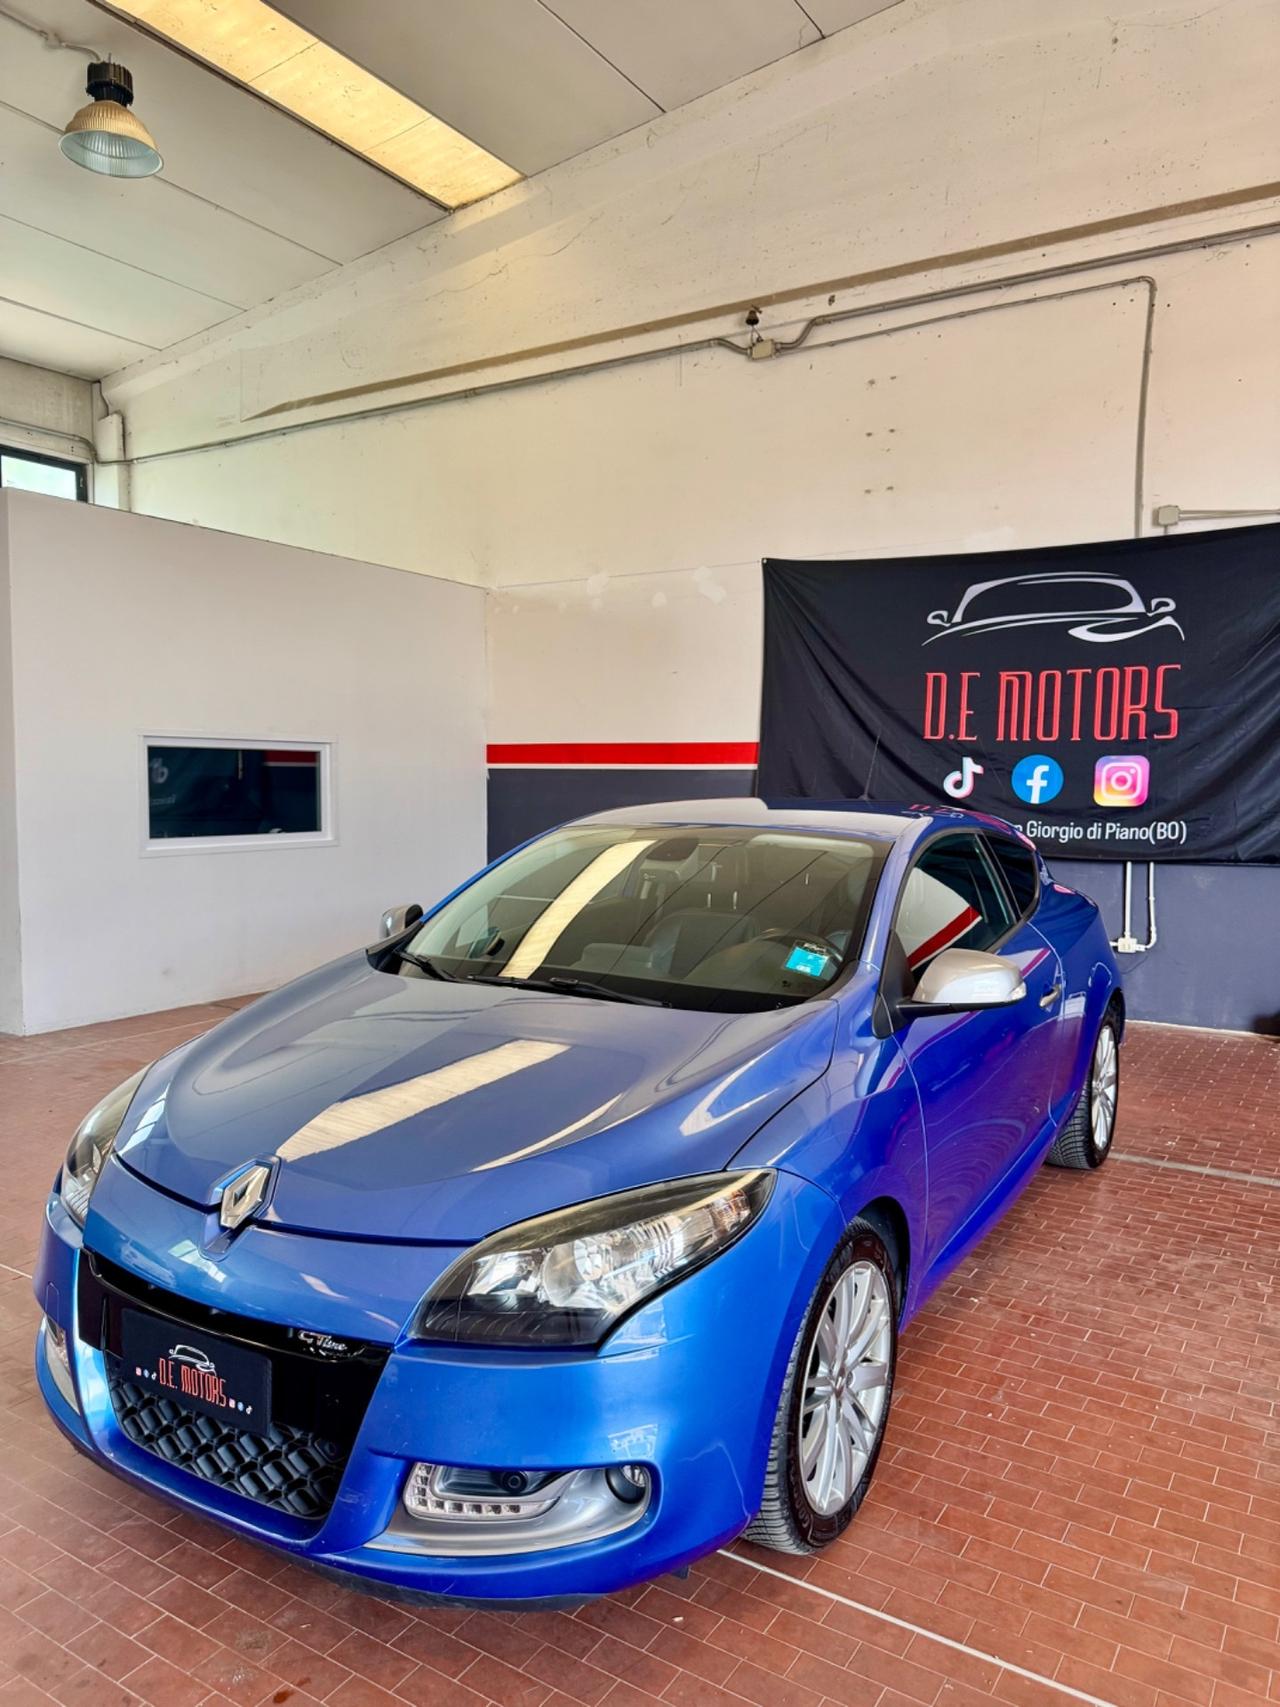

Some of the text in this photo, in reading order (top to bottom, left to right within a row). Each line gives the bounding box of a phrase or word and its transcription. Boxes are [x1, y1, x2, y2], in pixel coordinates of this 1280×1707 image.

[924, 664, 1182, 742] D.E MOTORS
[1026, 820, 1084, 844] Giorgio
[1086, 822, 1102, 840] di
[181, 1365, 227, 1408] MOTORS
